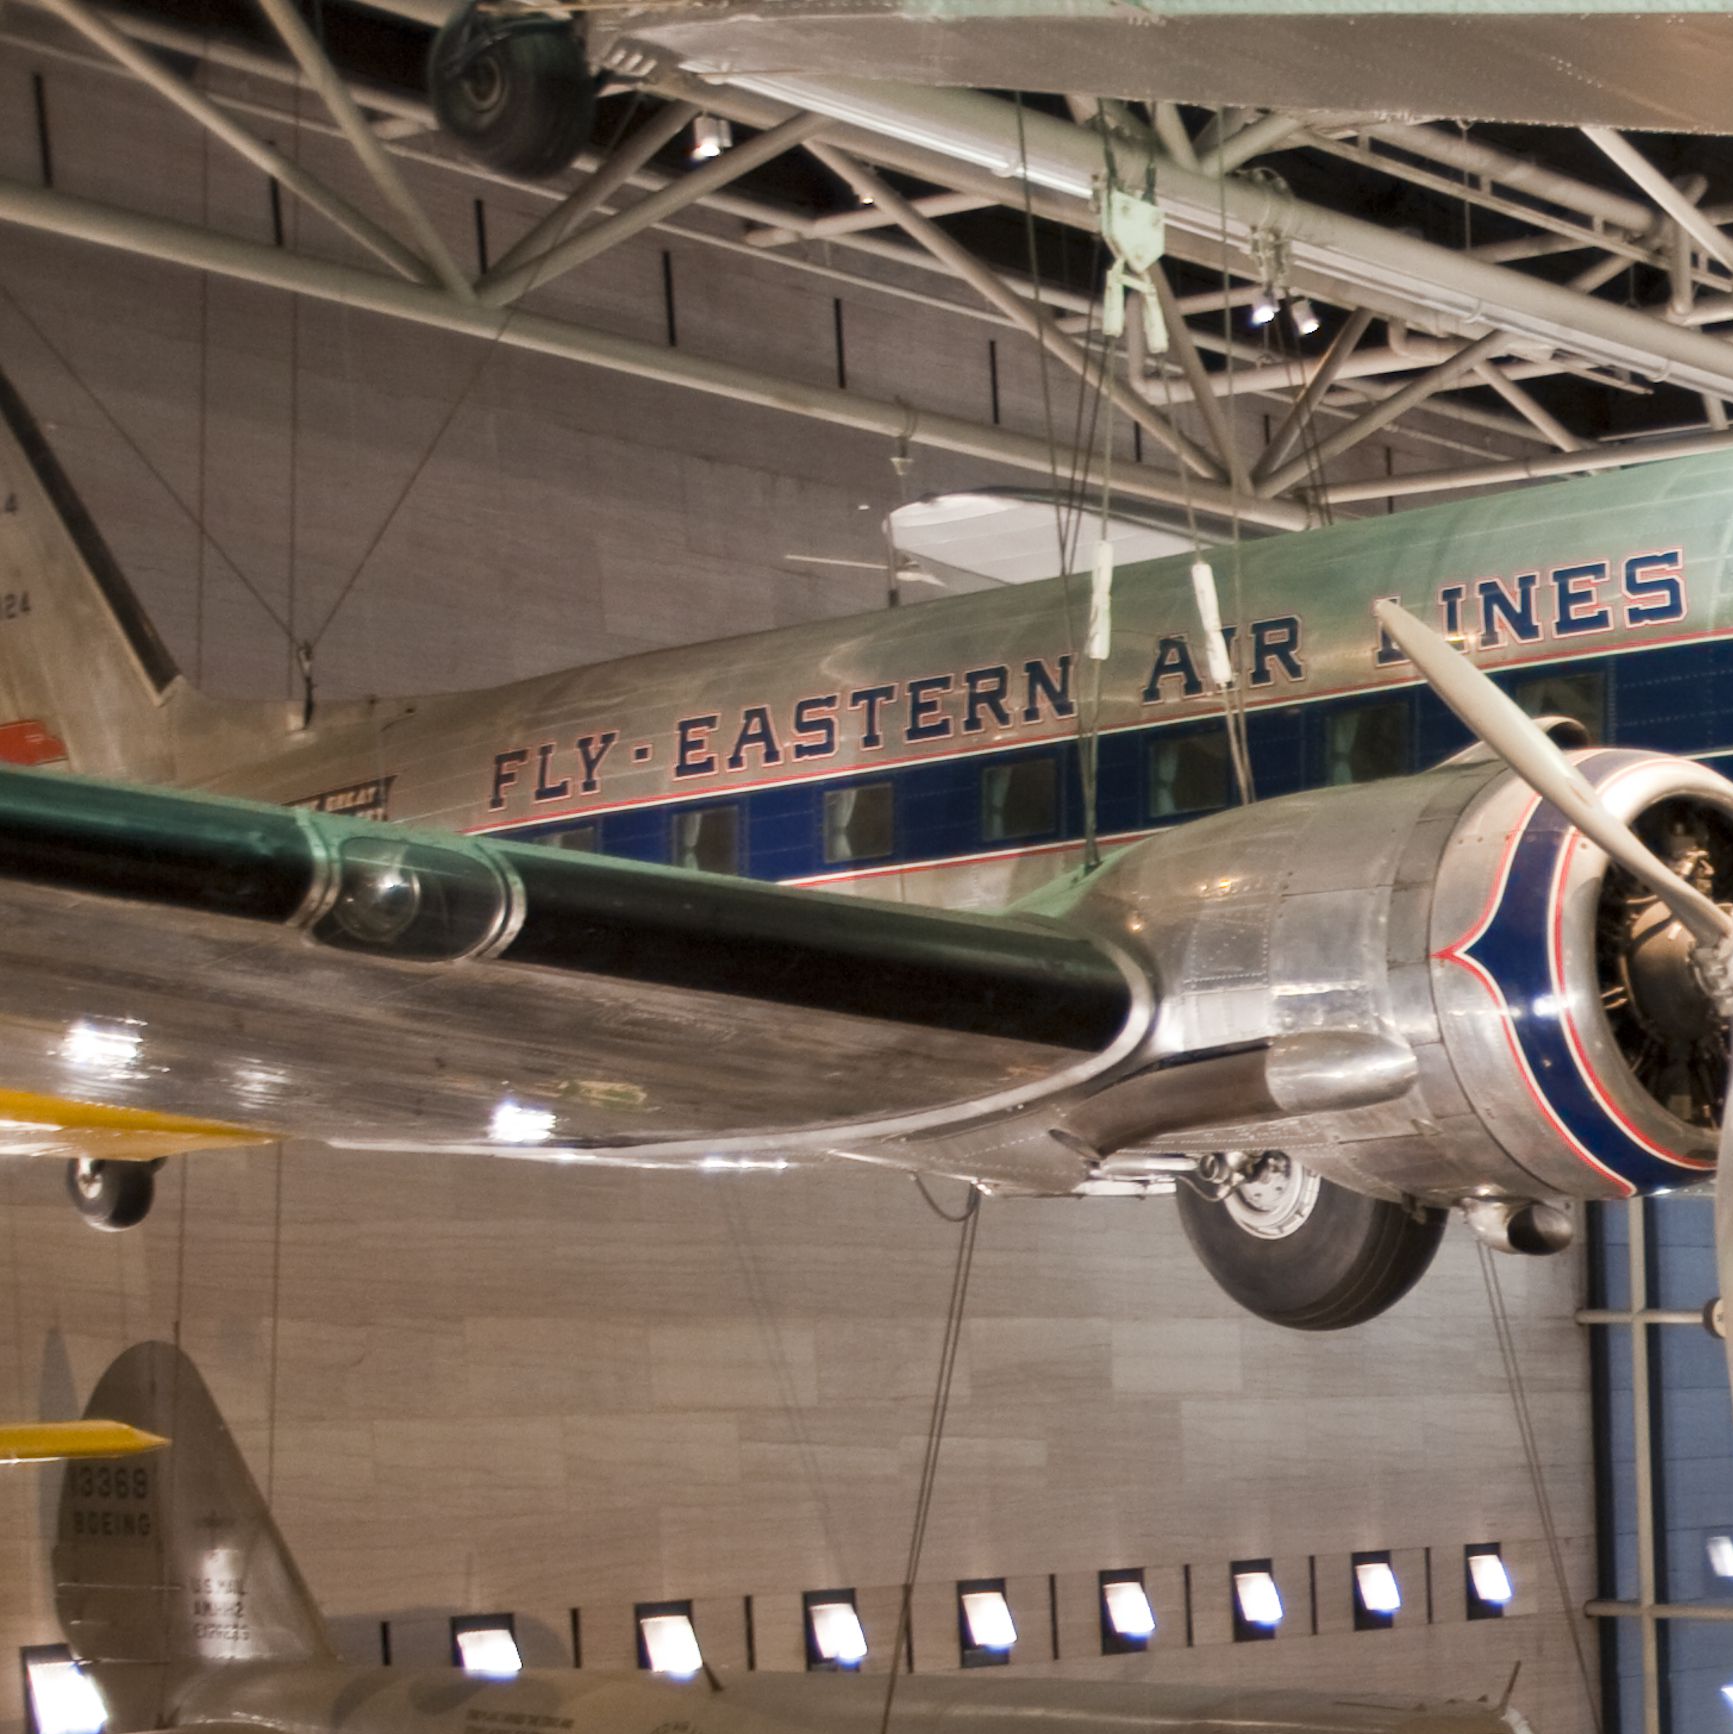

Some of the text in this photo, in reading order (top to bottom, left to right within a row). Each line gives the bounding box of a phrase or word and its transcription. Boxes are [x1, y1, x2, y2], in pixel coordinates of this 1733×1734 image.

[488, 730, 619, 813] FLY
[673, 653, 1080, 782] EASTERN
[74, 1511, 151, 1536] BOEING
